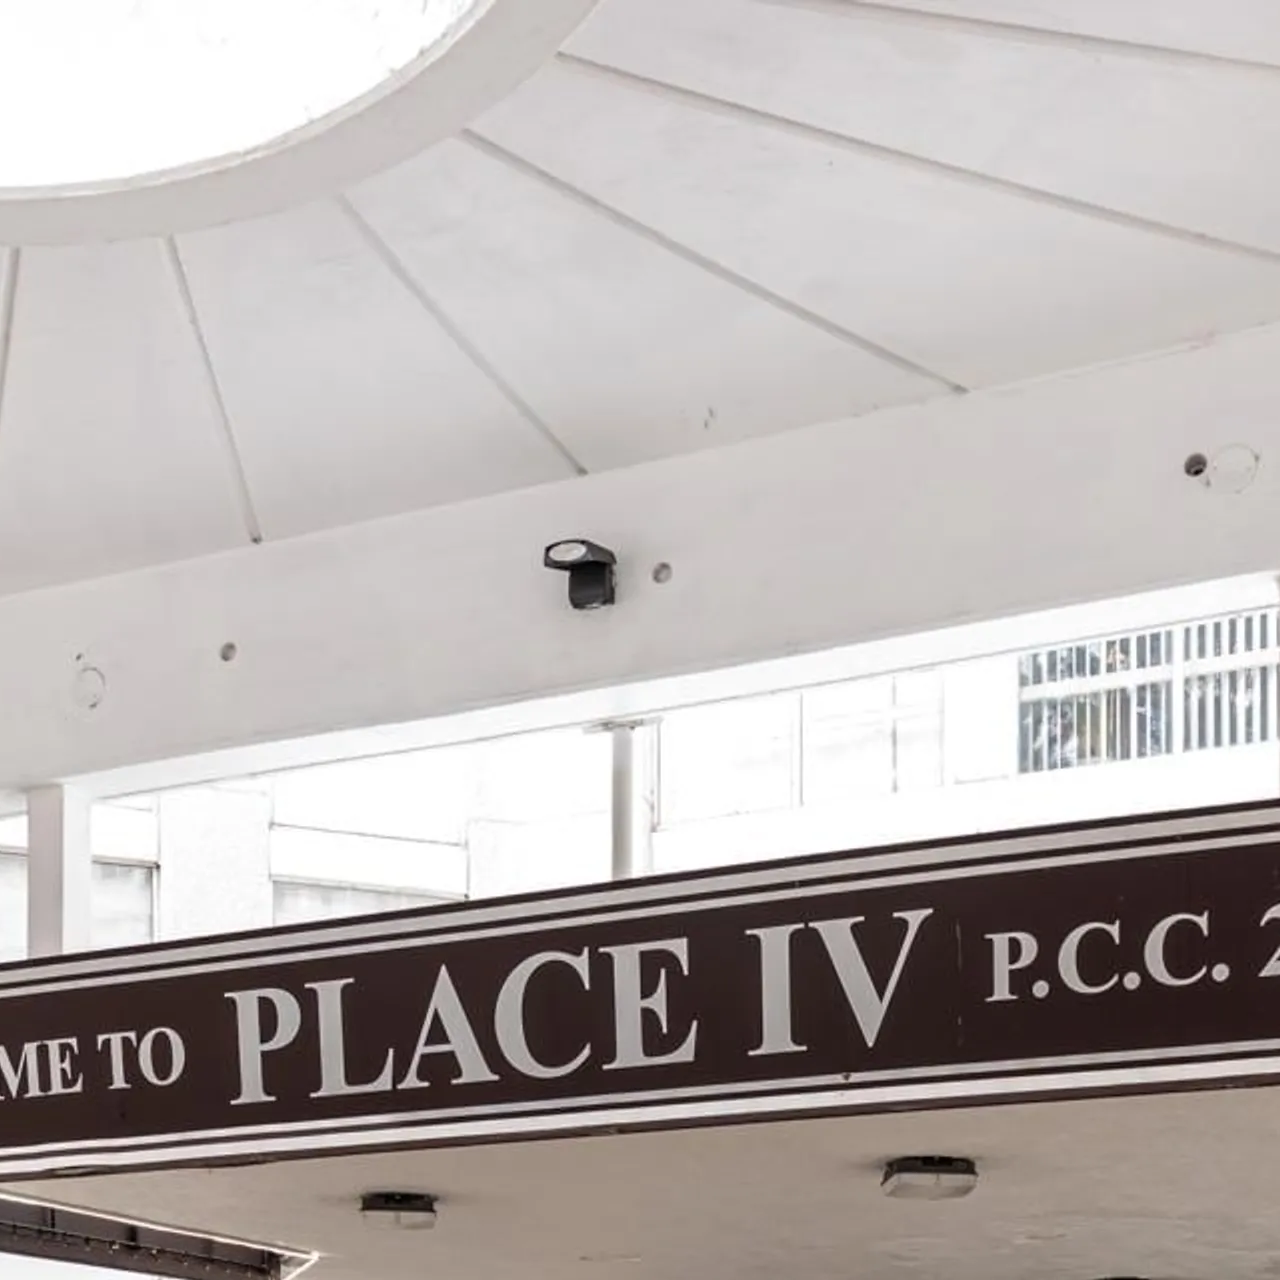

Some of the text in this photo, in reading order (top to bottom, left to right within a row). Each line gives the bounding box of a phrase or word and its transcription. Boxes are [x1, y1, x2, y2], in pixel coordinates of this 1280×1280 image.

[96, 1026, 186, 1090] TO
[223, 936, 699, 1106] PLACE
[744, 907, 934, 1057] IV
[984, 910, 1231, 1003] P.C.C.
